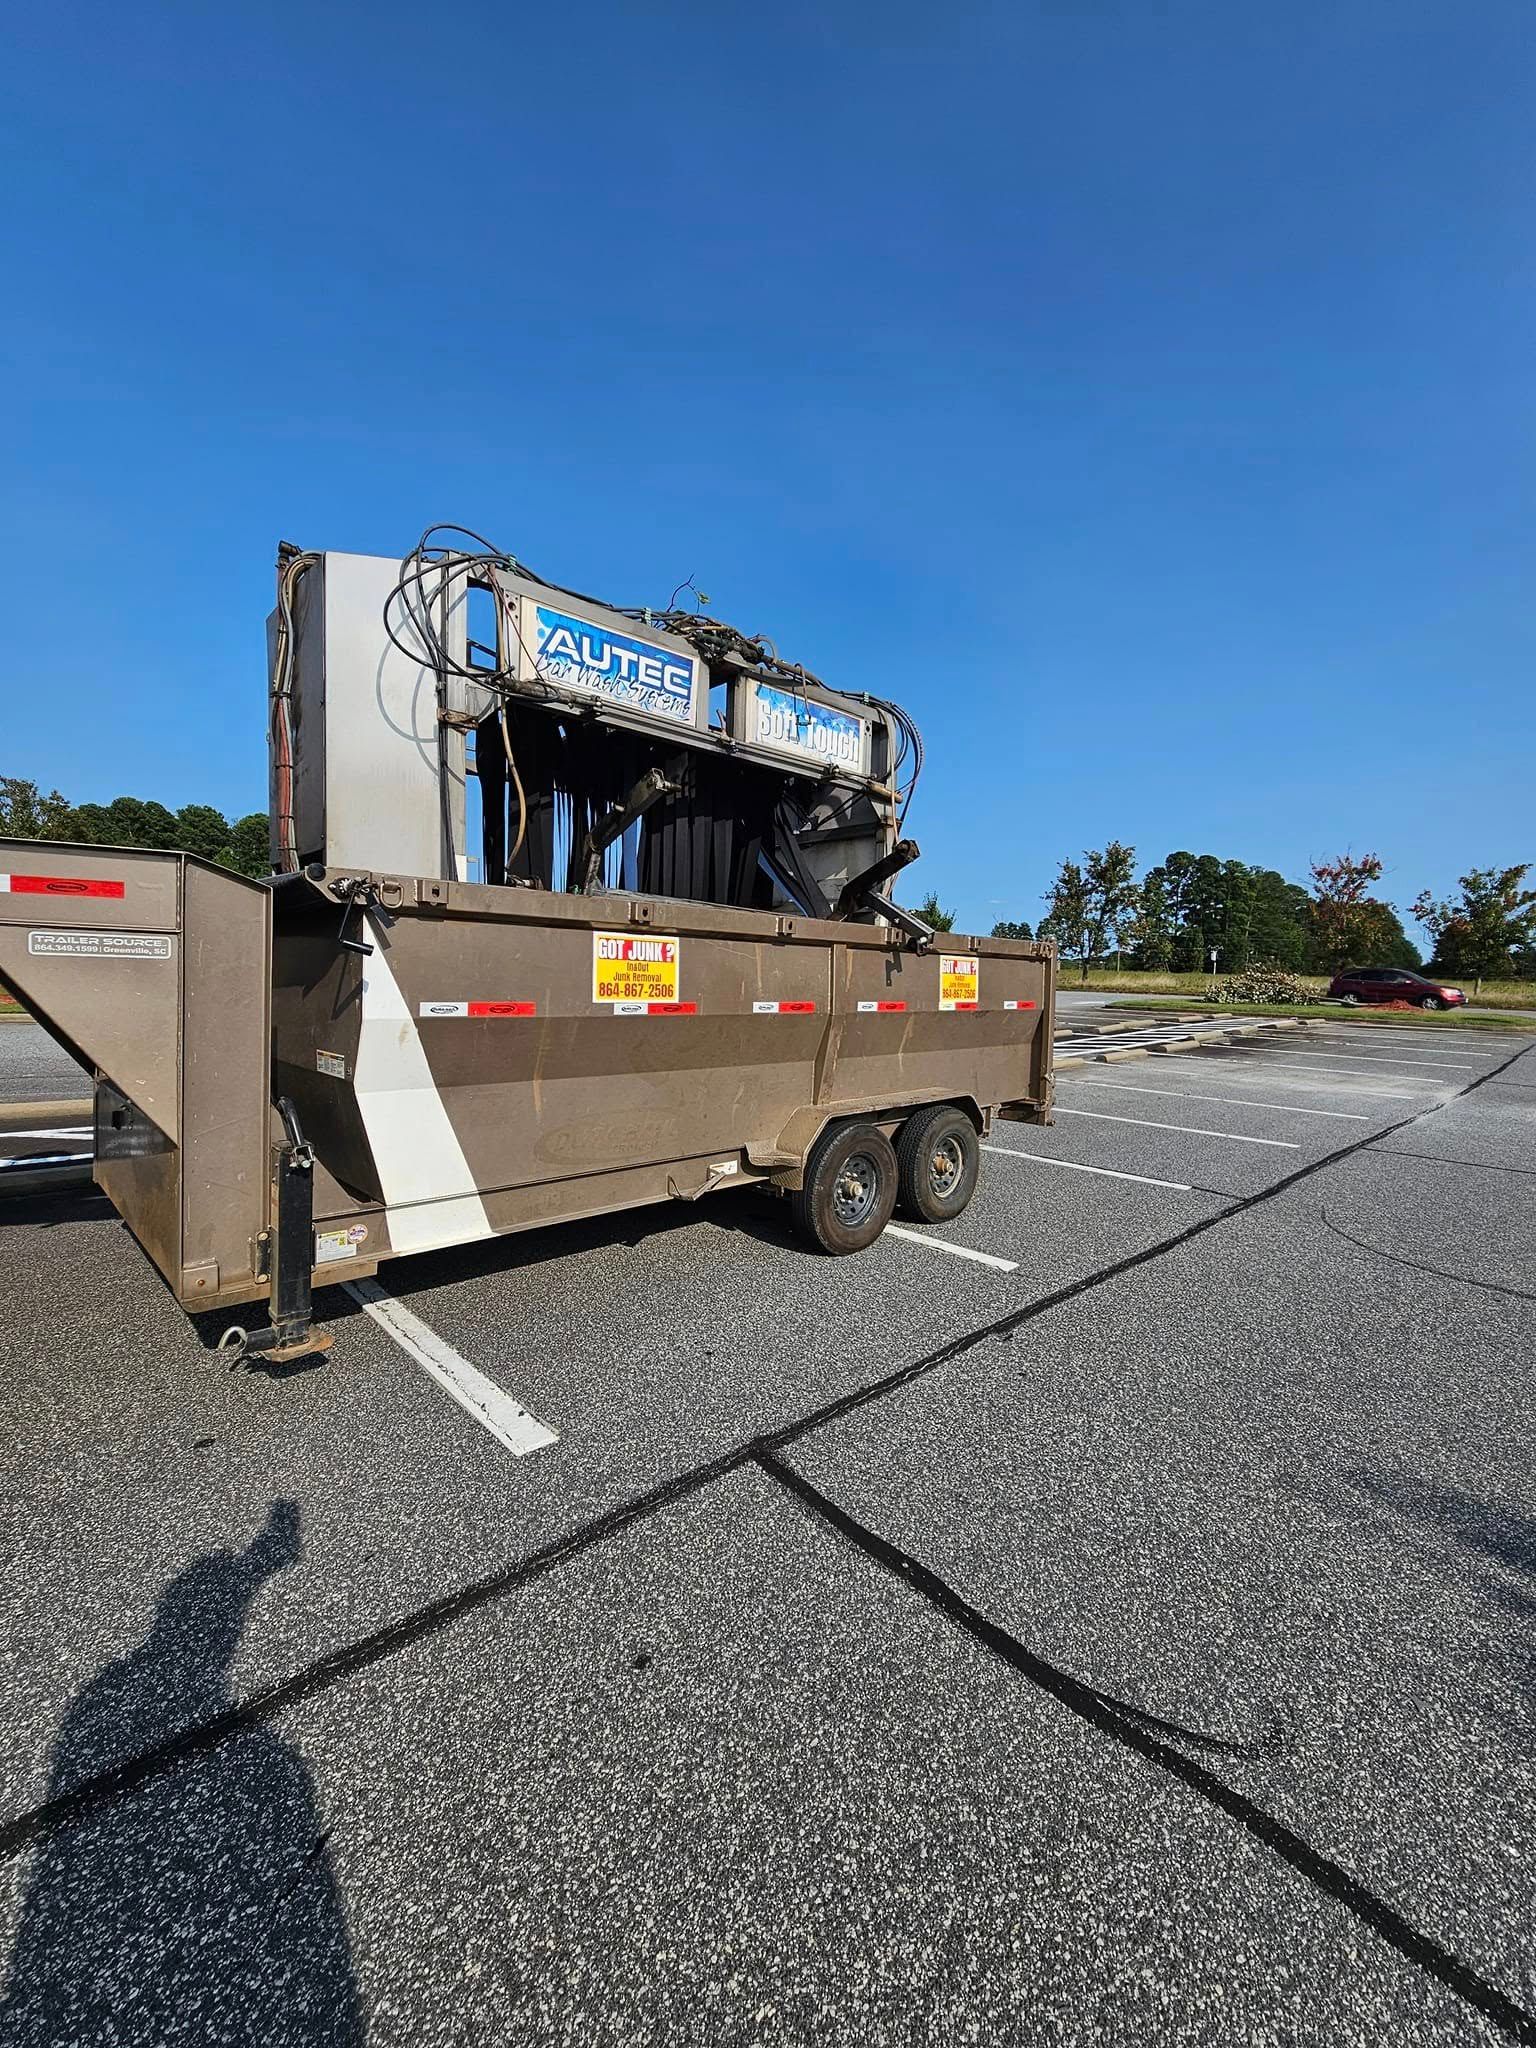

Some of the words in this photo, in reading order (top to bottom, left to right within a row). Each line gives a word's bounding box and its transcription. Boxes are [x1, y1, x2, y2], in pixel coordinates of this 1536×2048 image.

[540, 626, 691, 699] AUTEC
[536, 652, 572, 679] Car
[578, 663, 623, 697] Wash
[626, 679, 691, 715] Systems
[757, 700, 800, 745] Soft
[805, 715, 860, 763] Touch
[34, 935, 100, 945] TRAILER
[103, 937, 162, 947] SOURCE
[34, 943, 98, 953] 864.349.1599
[103, 946, 153, 955] Greenville,
[153, 947, 167, 955] SC
[599, 938, 624, 960] GOT
[628, 940, 663, 962] JUNK
[613, 972, 631, 982] Junk
[632, 972, 662, 983] Removal
[598, 981, 674, 998] 864-867-2506
